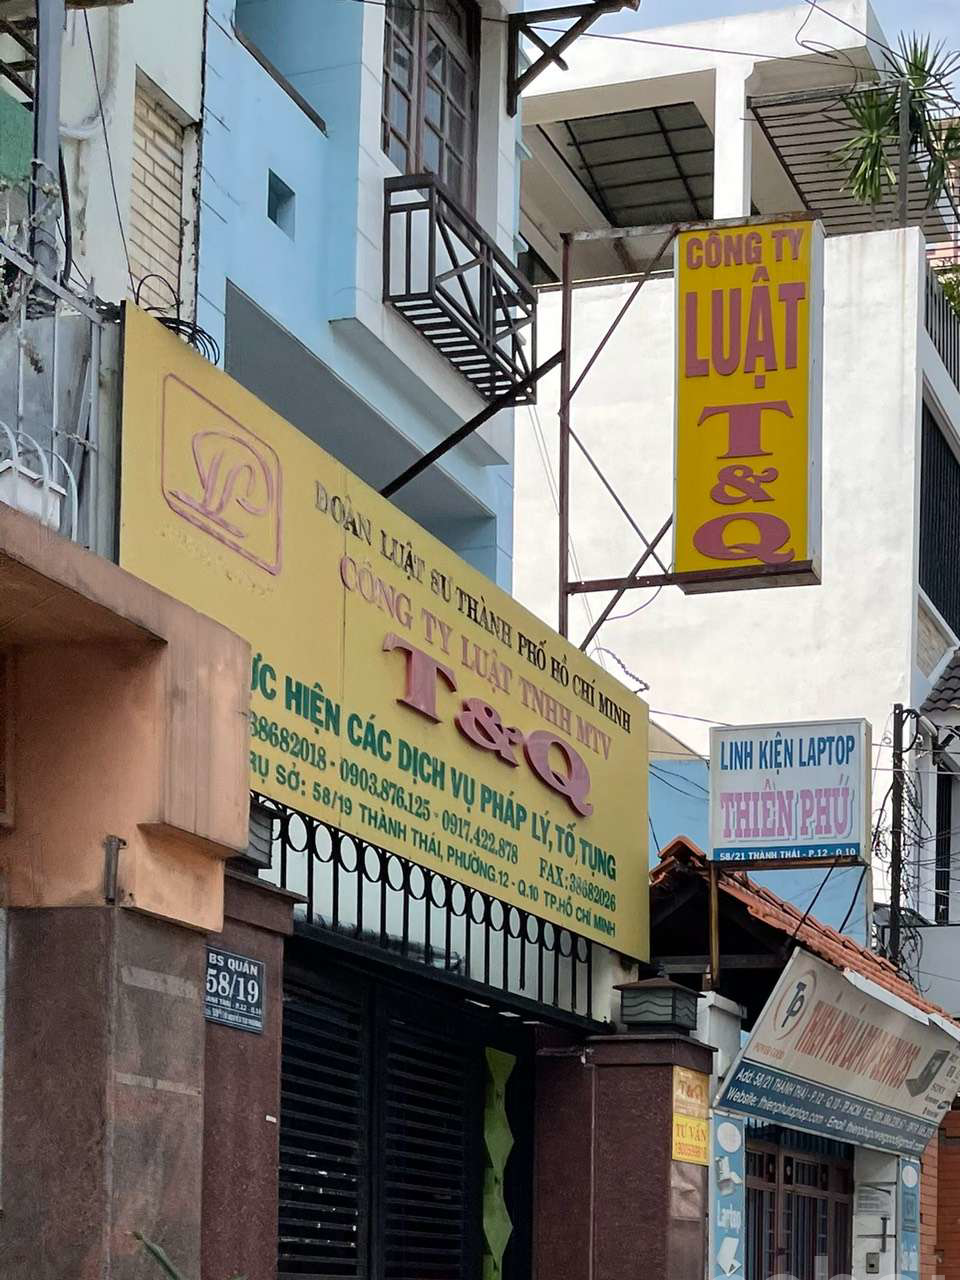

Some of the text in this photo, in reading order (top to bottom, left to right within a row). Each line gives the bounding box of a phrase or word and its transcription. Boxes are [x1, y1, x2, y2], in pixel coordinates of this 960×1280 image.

[686, 228, 805, 270] CÔNG TY
[684, 265, 806, 389] LUẬT
[697, 400, 794, 460] T
[338, 554, 414, 631] CÔNG
[421, 607, 453, 657] TY
[460, 634, 514, 695] LUẬT
[519, 675, 573, 736] TNHH
[575, 714, 613, 761] MTV
[380, 528, 425, 585] LUẬT
[456, 586, 513, 649] THÀNH
[517, 631, 547, 671] PHỐ
[550, 653, 570, 688] HỒ
[572, 673, 596, 708] CHÍ
[598, 691, 632, 734] MINH
[383, 631, 594, 818] T&Q
[720, 731, 856, 775] LINH KIỆN LAPTOP
[285, 673, 341, 737] HIỆN
[347, 711, 392, 762] CÁC
[398, 738, 446, 791] DỊCH
[450, 766, 476, 813] VỤ
[480, 783, 528, 831] PHÁP
[578, 836, 617, 882] TỤNG
[339, 756, 431, 822] 0903.876.125
[441, 809, 519, 865] 0917.422.878
[799, 773, 852, 838] PHÚ
[312, 781, 353, 816] 58/19
[359, 802, 407, 842] THÀNH
[517, 879, 539, 902] Q.10
[593, 913, 616, 938] MINH
[720, 851, 745, 861] 58/21
[748, 850, 778, 860] THÀNH
[780, 848, 801, 858] THÁI
[808, 848, 828, 858] P.12
[206, 967, 259, 1004] 58/19
[208, 952, 258, 977] BS QUÁN
